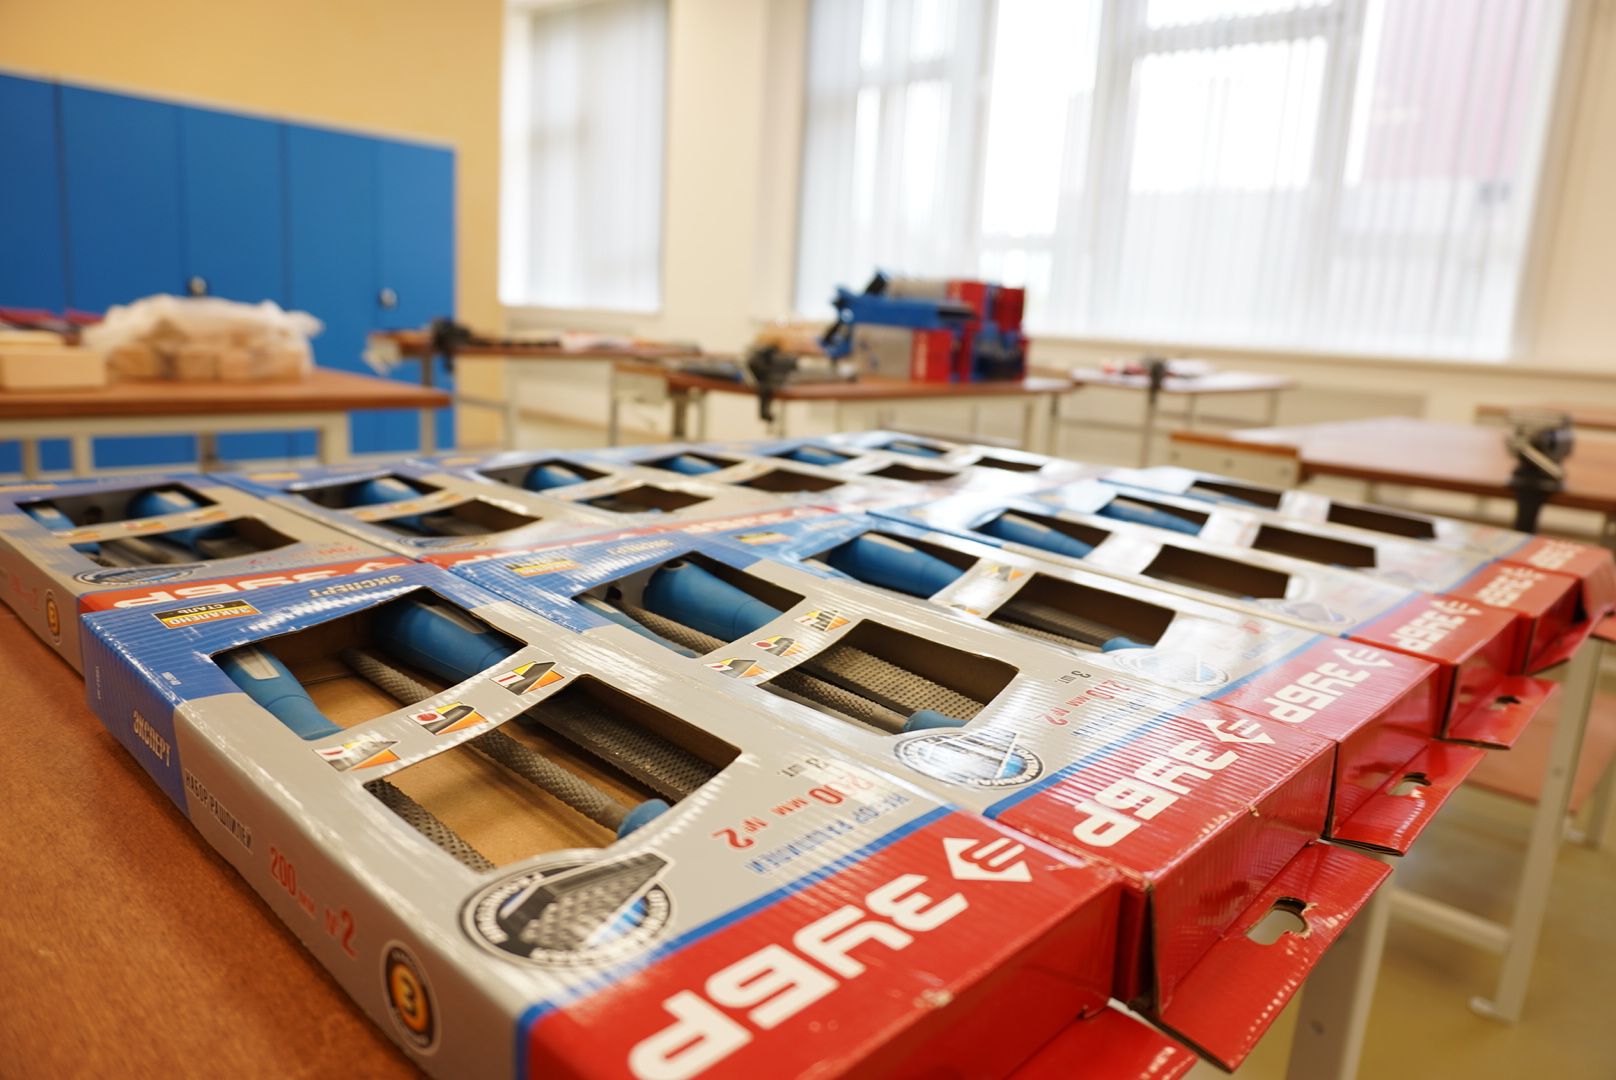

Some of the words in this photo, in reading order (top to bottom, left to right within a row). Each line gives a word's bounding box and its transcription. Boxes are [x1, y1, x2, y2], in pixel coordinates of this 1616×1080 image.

[178, 603, 225, 615] СТАЛЬ
[309, 575, 405, 598] ЭКСПЕРТ
[169, 607, 251, 626] ЗАКАЛЕНО
[1389, 607, 1467, 652] ЗУБР
[1263, 663, 1371, 723] ЗУБР
[132, 710, 171, 768] ЭКСПЕРТ
[185, 768, 208, 807] НАБОР
[856, 793, 909, 825] НАОР
[1072, 740, 1240, 848] ЗУБР
[269, 846, 297, 897] 200
[628, 873, 969, 1080] ЗУБР
